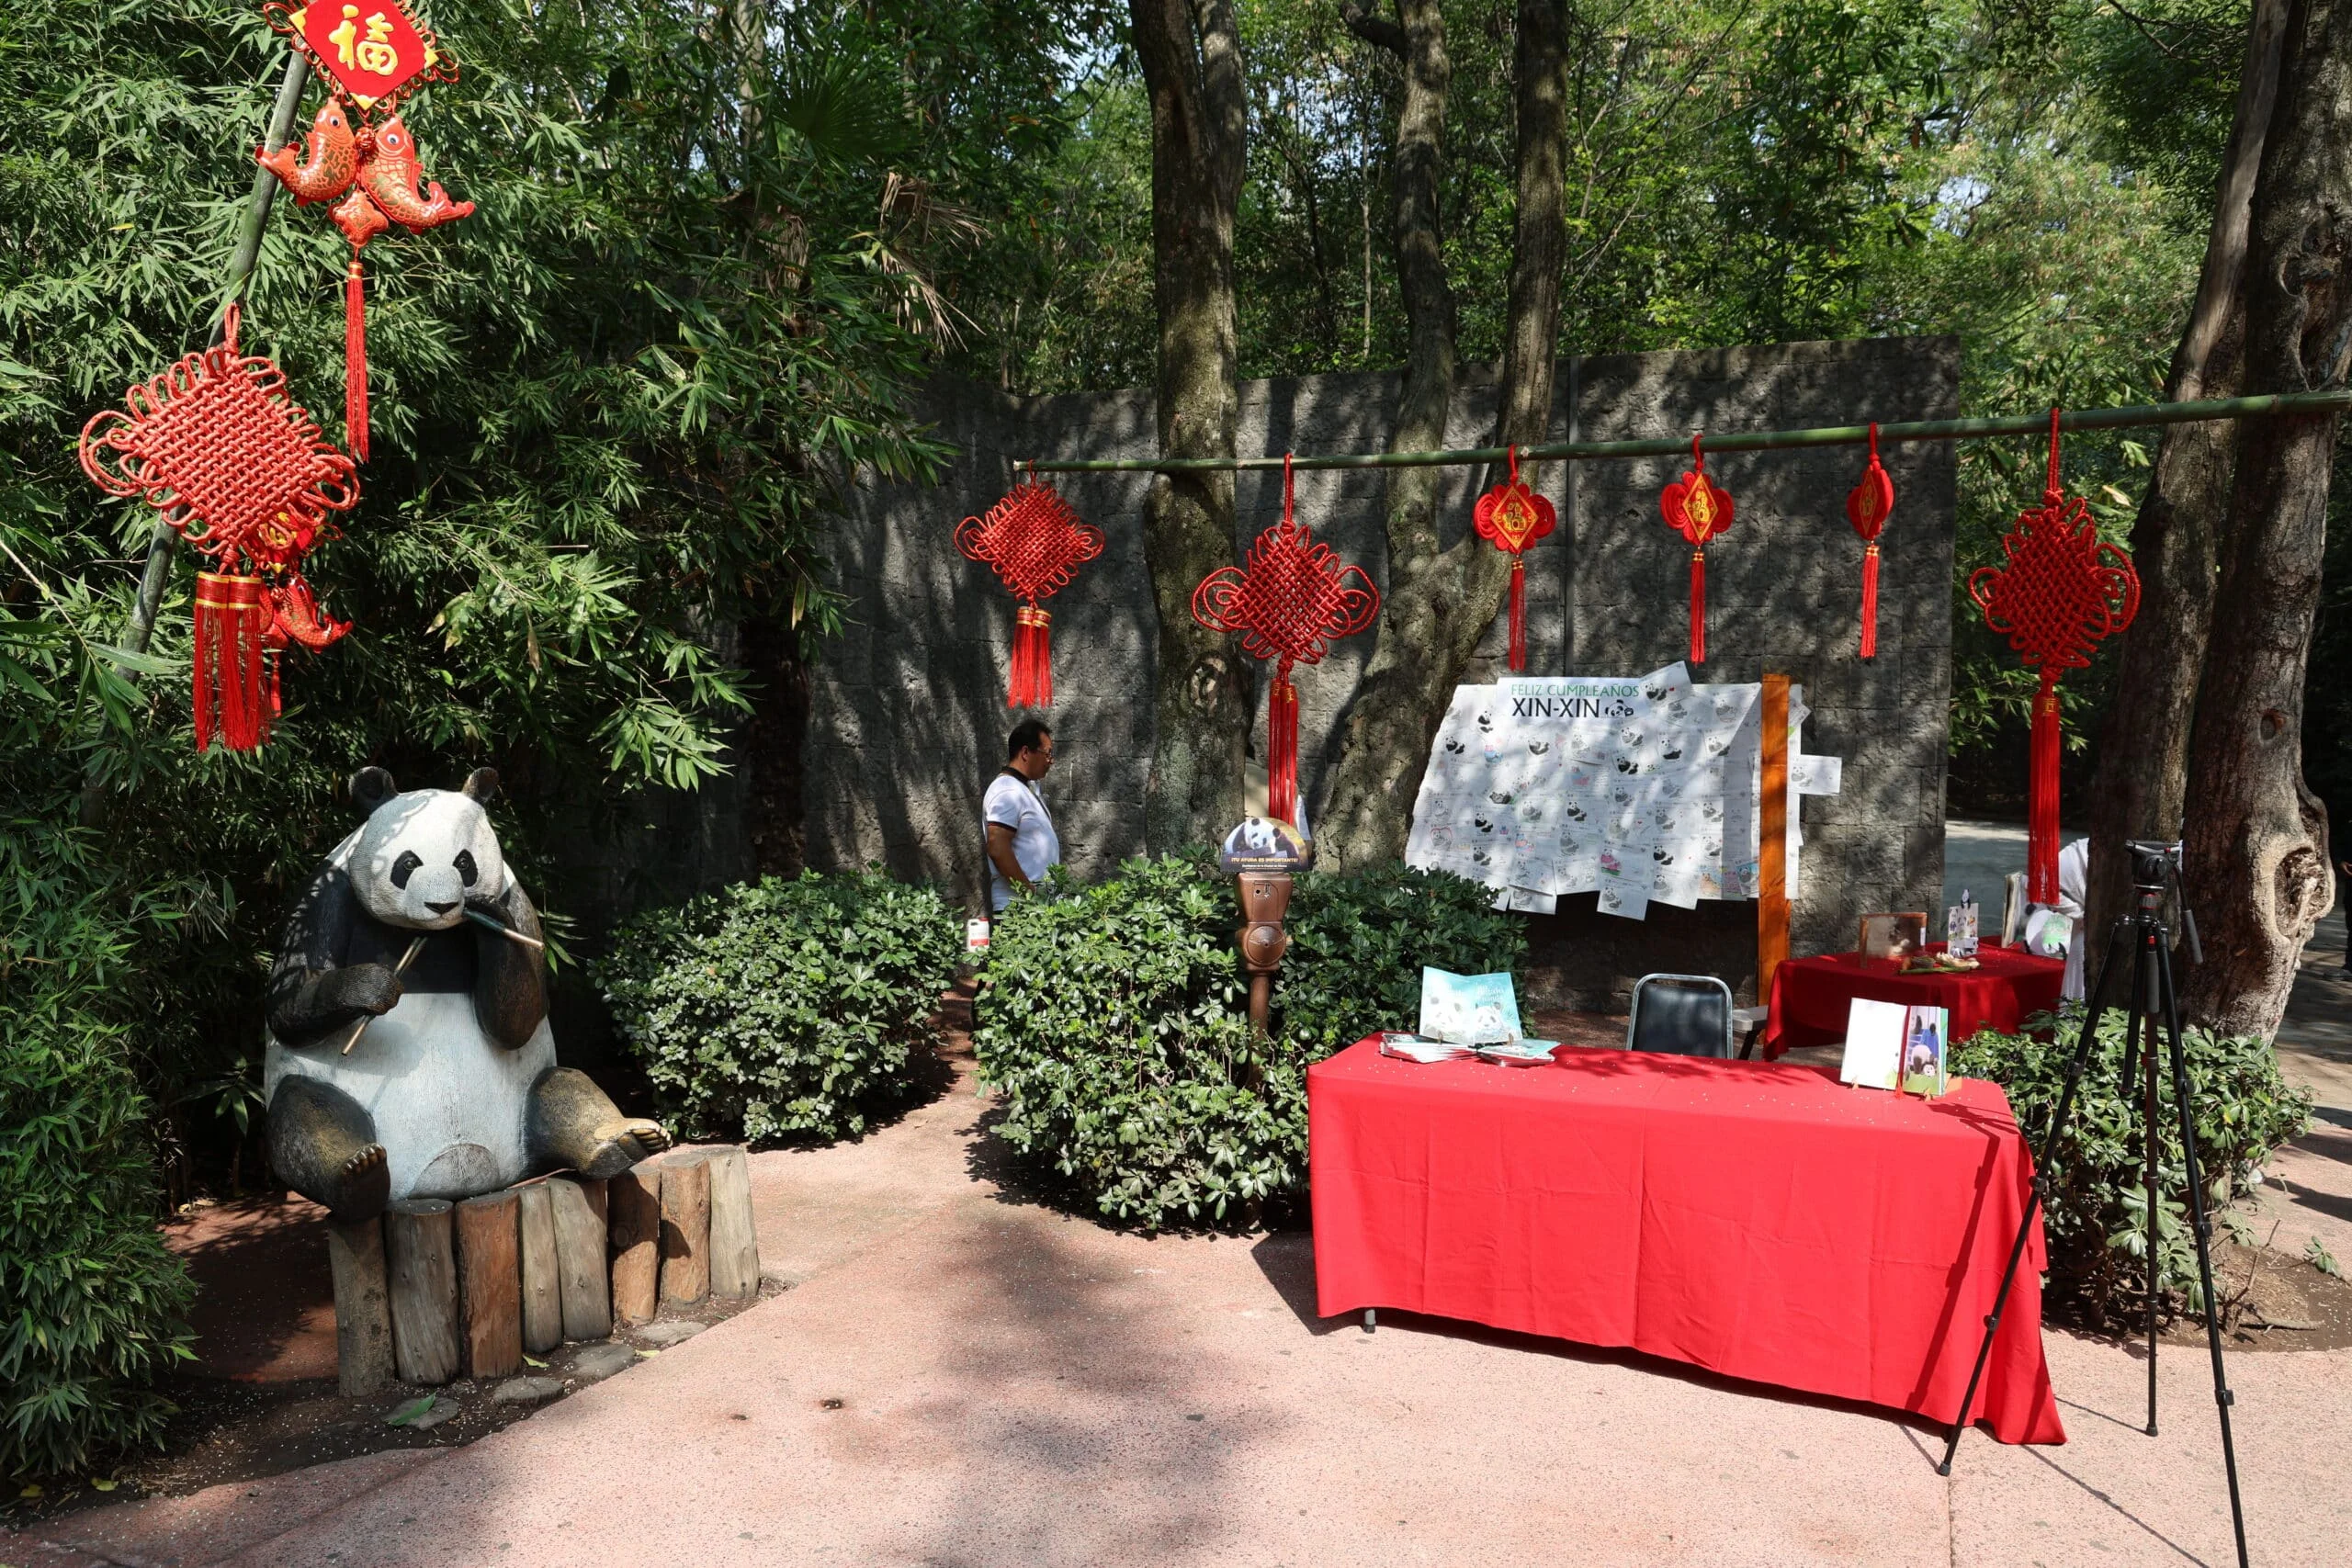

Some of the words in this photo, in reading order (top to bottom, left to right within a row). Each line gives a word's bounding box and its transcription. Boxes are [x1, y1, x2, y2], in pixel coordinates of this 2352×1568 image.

[328, 4, 398, 76] 福
[1511, 684, 1544, 696] FELIZ
[1547, 683, 1639, 697] CUMPLEAÑOS
[1512, 697, 1600, 718] XIN-XIN
